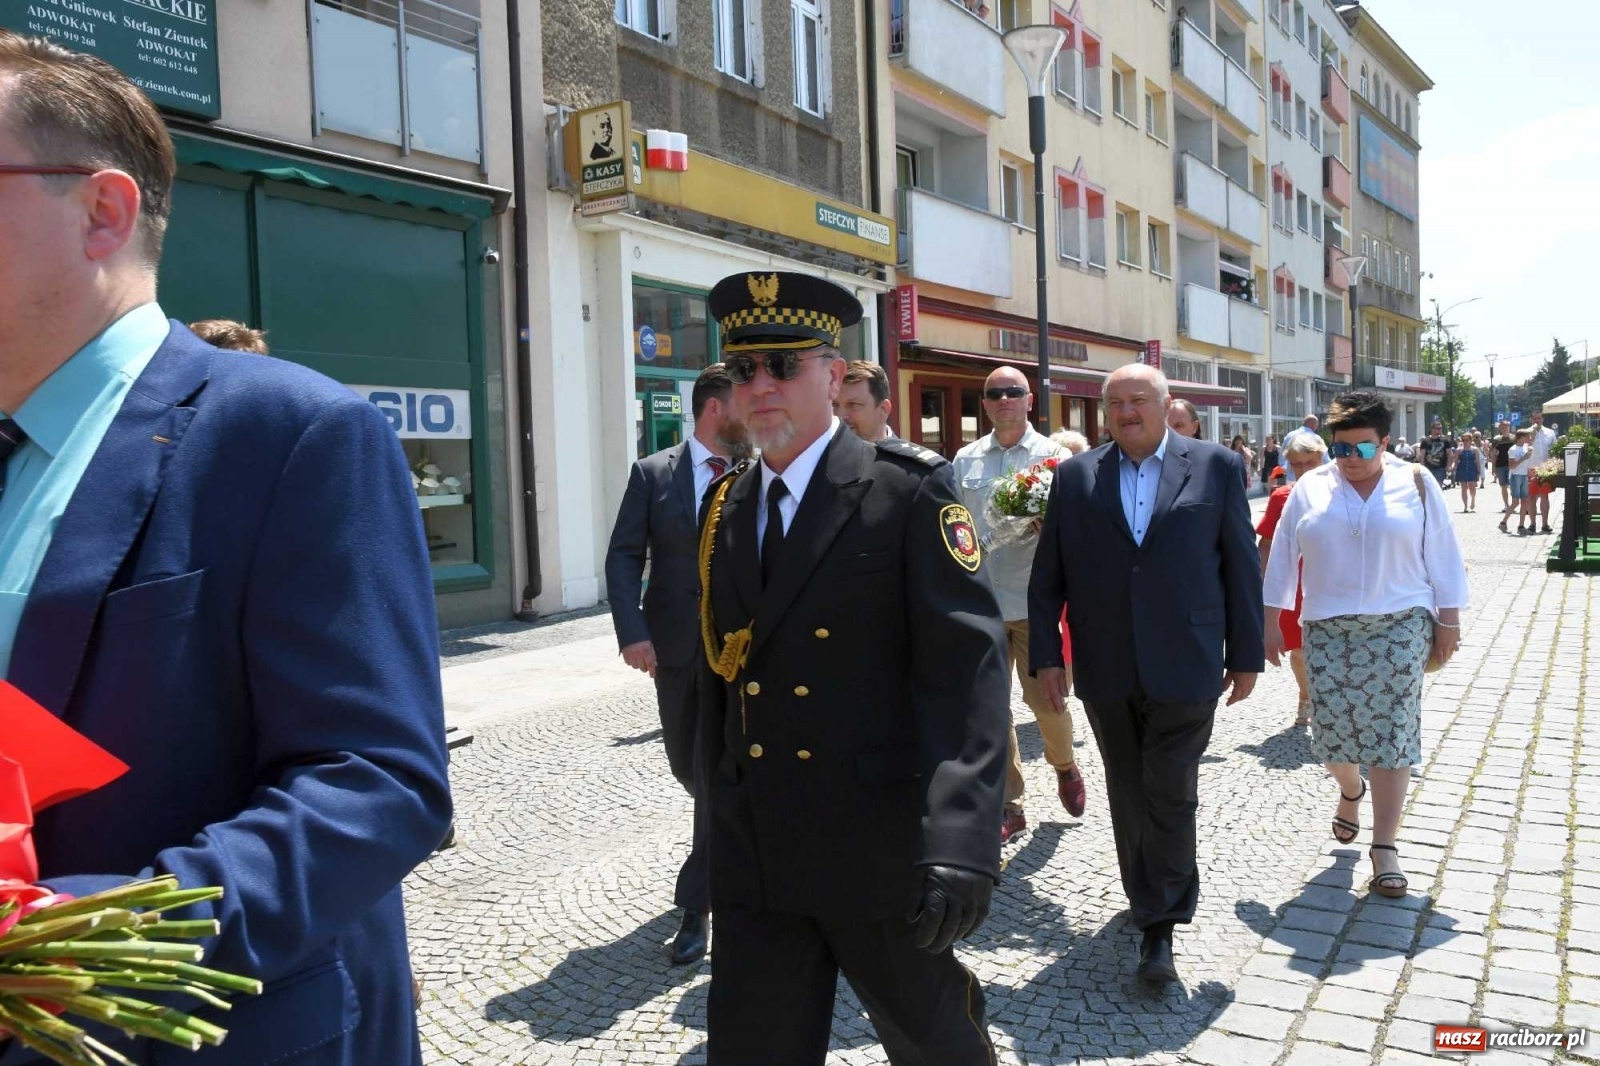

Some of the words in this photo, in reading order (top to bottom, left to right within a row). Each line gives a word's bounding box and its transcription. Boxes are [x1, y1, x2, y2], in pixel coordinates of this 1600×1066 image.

[27, 5, 96, 34] ADWOKAT
[61, 0, 117, 24] Gniewek
[29, 22, 44, 32] tel:
[46, 26, 60, 37] 661
[63, 31, 79, 42] 919
[81, 36, 96, 47] 268
[123, 15, 161, 37] Stefan
[164, 27, 208, 50] Zientek
[136, 38, 198, 62] ADWOKAT
[138, 53, 151, 63] tel:
[153, 57, 167, 67] 602
[168, 60, 182, 71] 612
[184, 65, 198, 75] 648
[596, 163, 621, 177] KASY
[585, 178, 623, 193] STEFCZYKA
[818, 207, 856, 231] STEFCZYK
[859, 220, 888, 242] FINANSE
[369, 391, 455, 433] SIO
